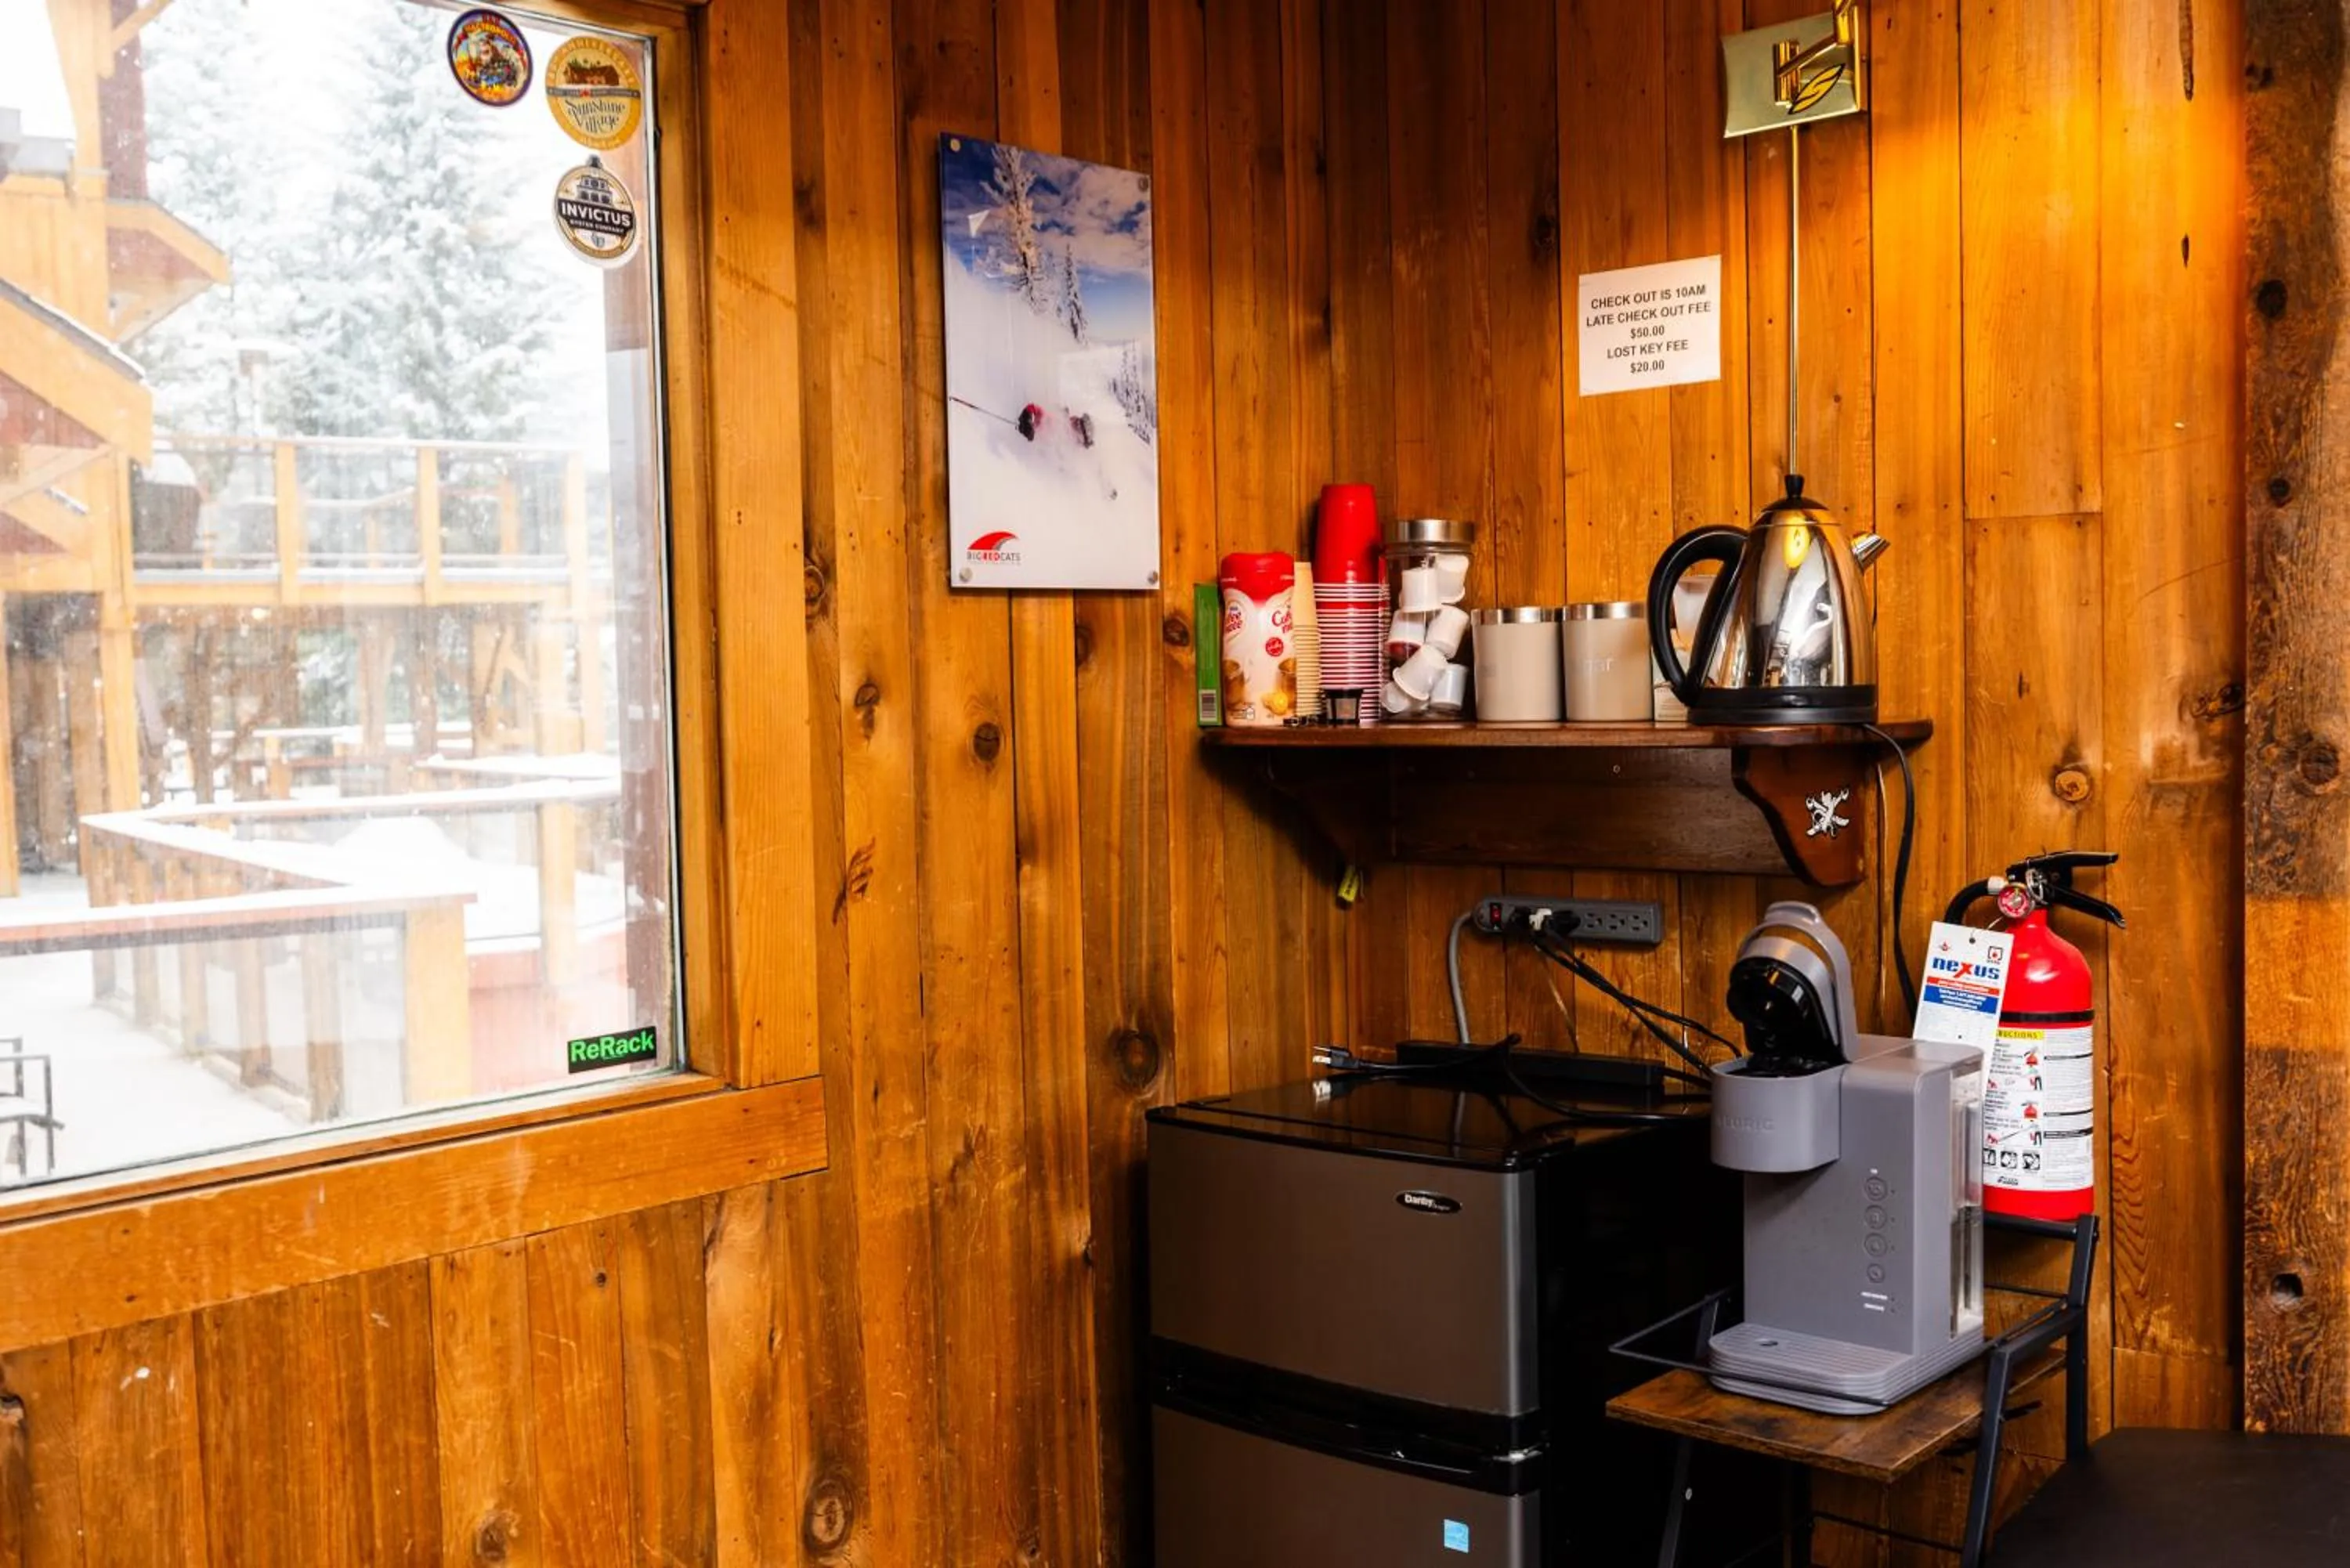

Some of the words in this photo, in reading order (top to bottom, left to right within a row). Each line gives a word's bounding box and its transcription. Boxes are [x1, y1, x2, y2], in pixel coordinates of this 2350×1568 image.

[561, 202, 631, 226] INVICTUS
[1591, 294, 1630, 309] CHECK
[1634, 291, 1657, 304] OUT
[1661, 288, 1672, 300] IS
[1676, 284, 1706, 298] 10AM
[1586, 313, 1614, 327] LATE
[1618, 309, 1658, 323] CHECK
[1661, 305, 1685, 317] OUT
[1688, 302, 1711, 313] FEE
[1630, 325, 1665, 339] $50.00
[1607, 345, 1636, 359] LOST
[1640, 342, 1664, 355] KEY
[1666, 339, 1689, 352] FEE
[1630, 359, 1665, 374] $20.00
[1932, 957, 2000, 979] nexus
[570, 1030, 655, 1062] ReRack
